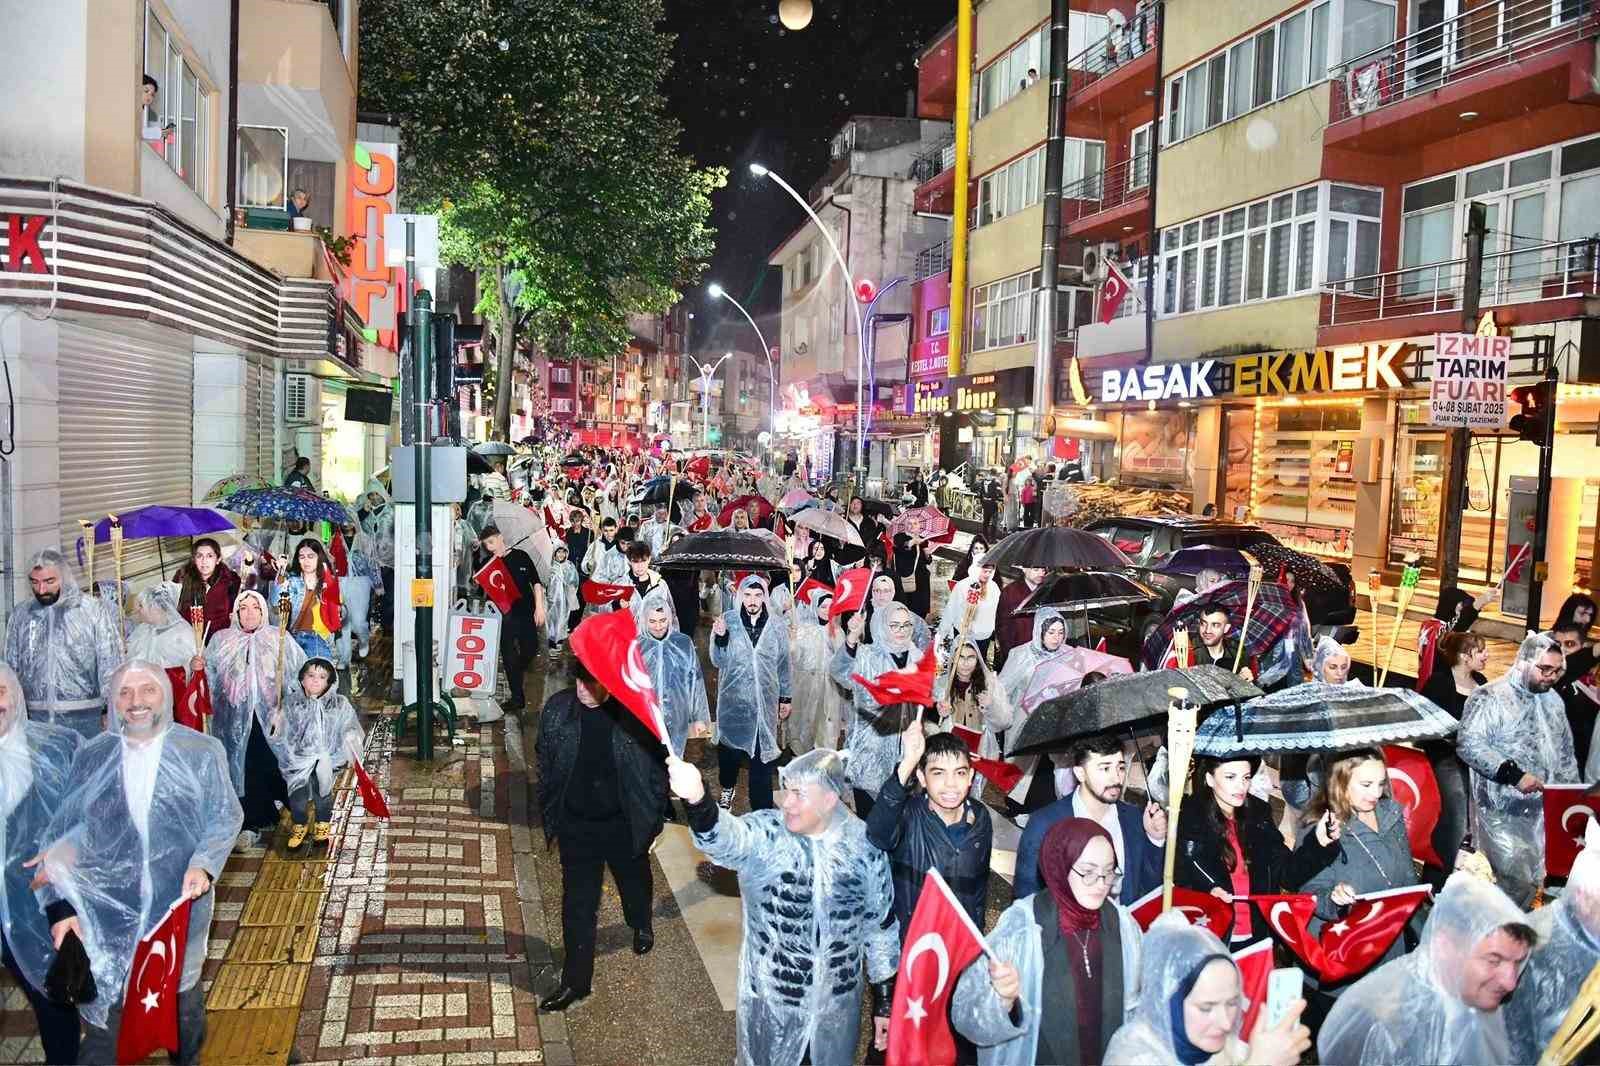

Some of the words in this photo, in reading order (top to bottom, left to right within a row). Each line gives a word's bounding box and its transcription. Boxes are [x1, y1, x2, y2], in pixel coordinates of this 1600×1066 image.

[8, 213, 50, 274] K
[1233, 341, 1405, 396] EKMEK
[1436, 358, 1506, 380] TARIM
[957, 387, 996, 410] Döner
[1432, 381, 1505, 402] FUARI
[1457, 402, 1482, 415] ŞUBAT
[1483, 403, 1504, 415] 2025
[453, 617, 486, 689] FOTO
